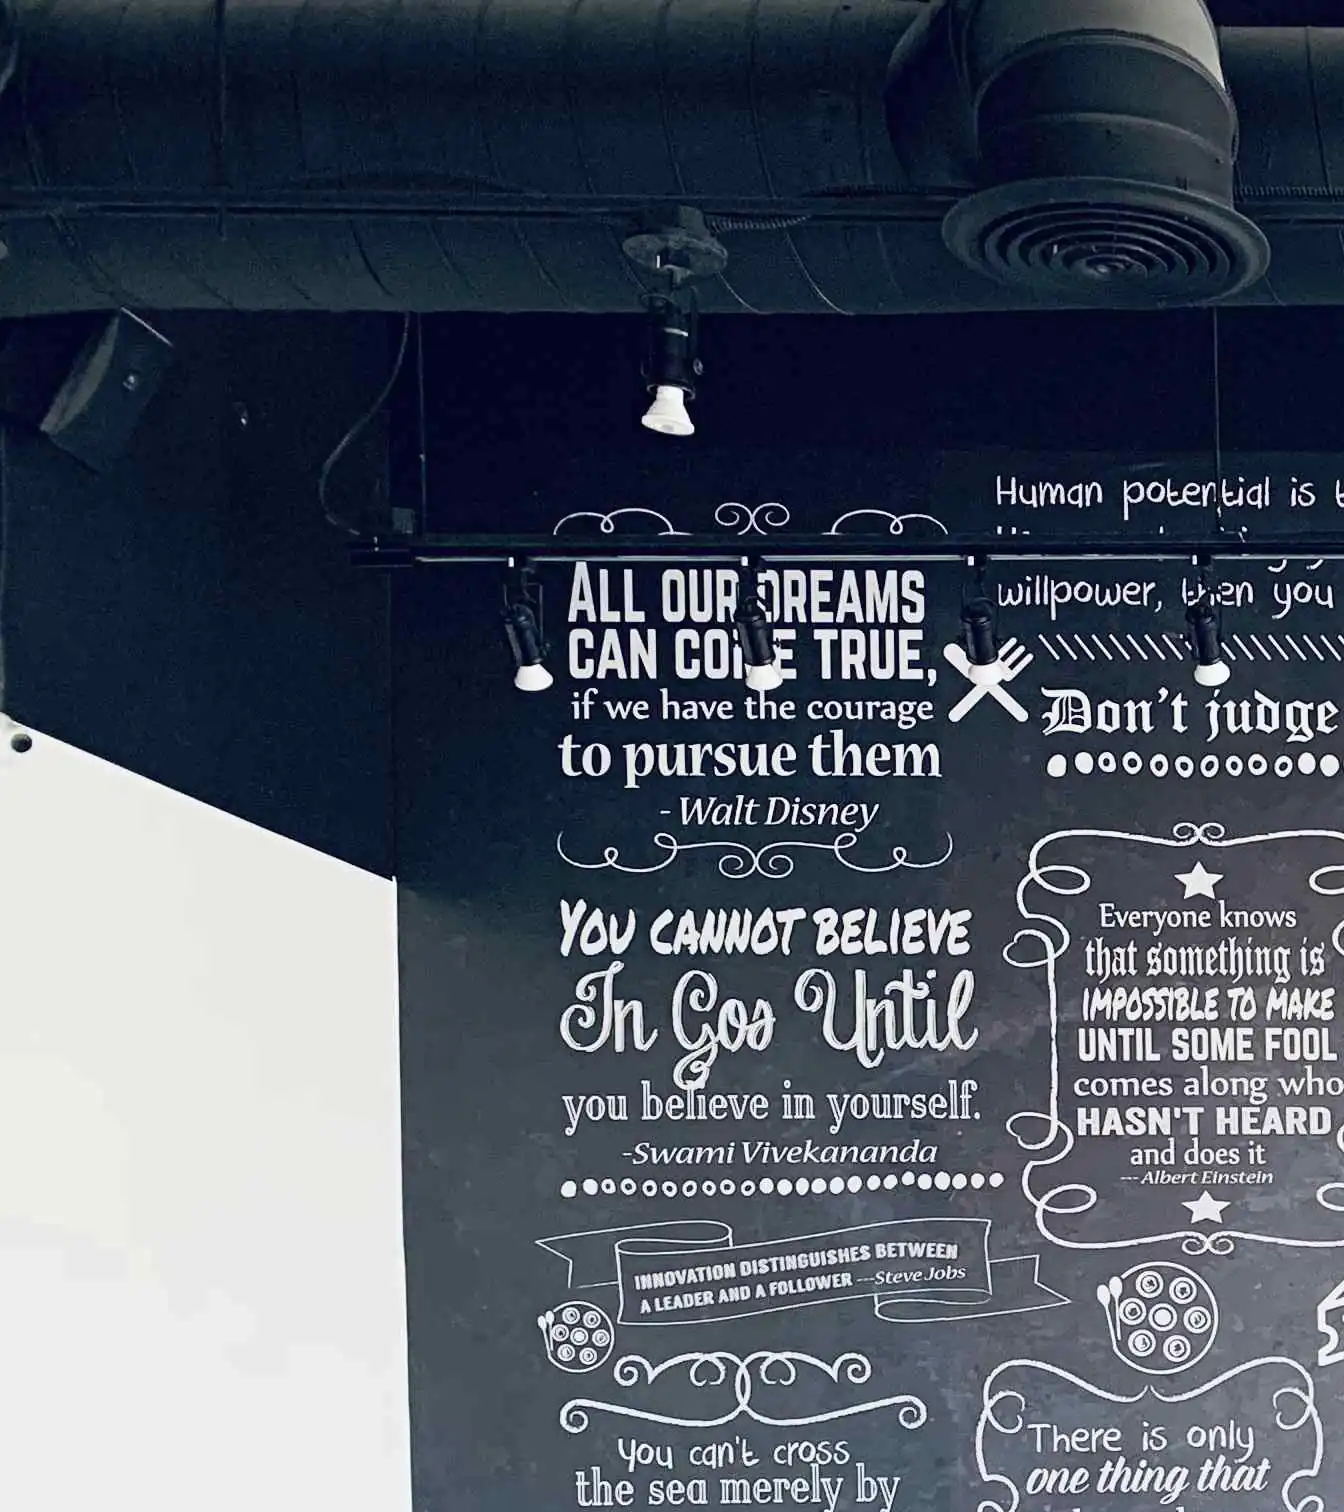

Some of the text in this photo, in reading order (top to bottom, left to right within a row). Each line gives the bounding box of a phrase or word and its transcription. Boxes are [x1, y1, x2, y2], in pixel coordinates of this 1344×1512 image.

[996, 475, 1103, 509] Human
[1123, 476, 1270, 521] potential
[1290, 476, 1316, 507] is
[571, 687, 934, 730] if we have the courage
[1040, 686, 1188, 736] Don't
[1204, 688, 1339, 743] judge
[557, 728, 943, 789] to pursue them
[649, 907, 807, 956] CANNOT
[812, 907, 972, 956] BELIEVE
[1078, 1027, 1338, 1062] UNTIL SOME FOOL
[561, 1079, 981, 1137] you believe in yourself.
[1073, 1064, 1344, 1106] comes along who
[1077, 1106, 1332, 1136] HASN'T HEARD
[634, 1242, 958, 1291] INNOVATION DISTINGUISHES BETWEEN
[639, 1272, 853, 1314] A LEADER AND A FOLLOWER
